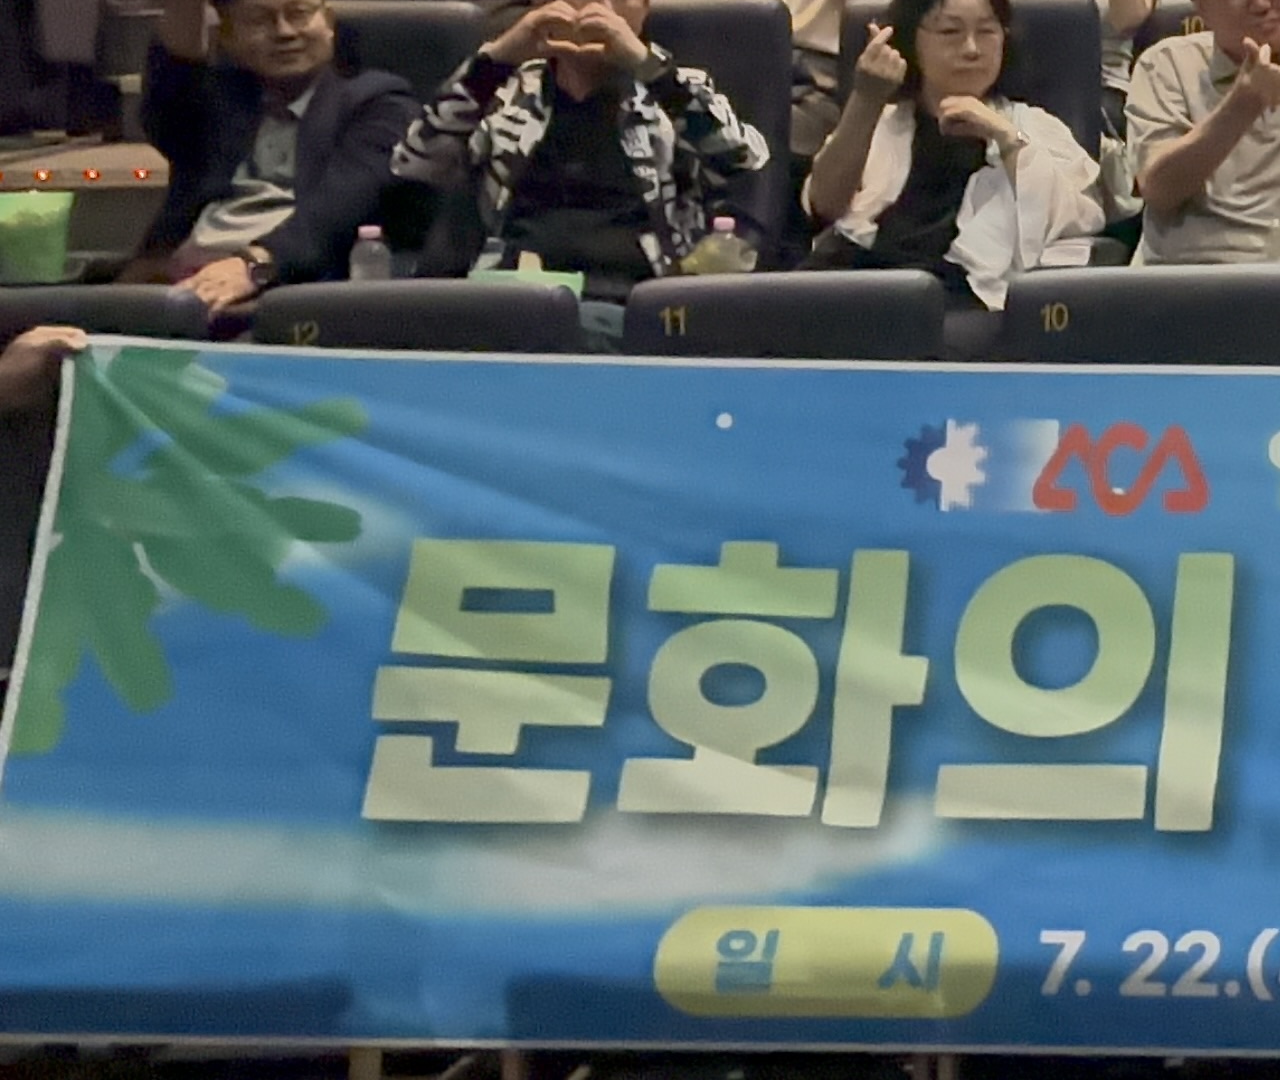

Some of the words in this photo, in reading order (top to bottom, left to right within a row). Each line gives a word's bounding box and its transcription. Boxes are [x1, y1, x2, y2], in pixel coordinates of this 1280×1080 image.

[659, 306, 686, 337] 11
[1041, 303, 1069, 333] 10
[362, 538, 1235, 831] 문화의
[714, 929, 779, 995] 일
[877, 930, 945, 994] 시
[1039, 929, 1091, 996] 7.
